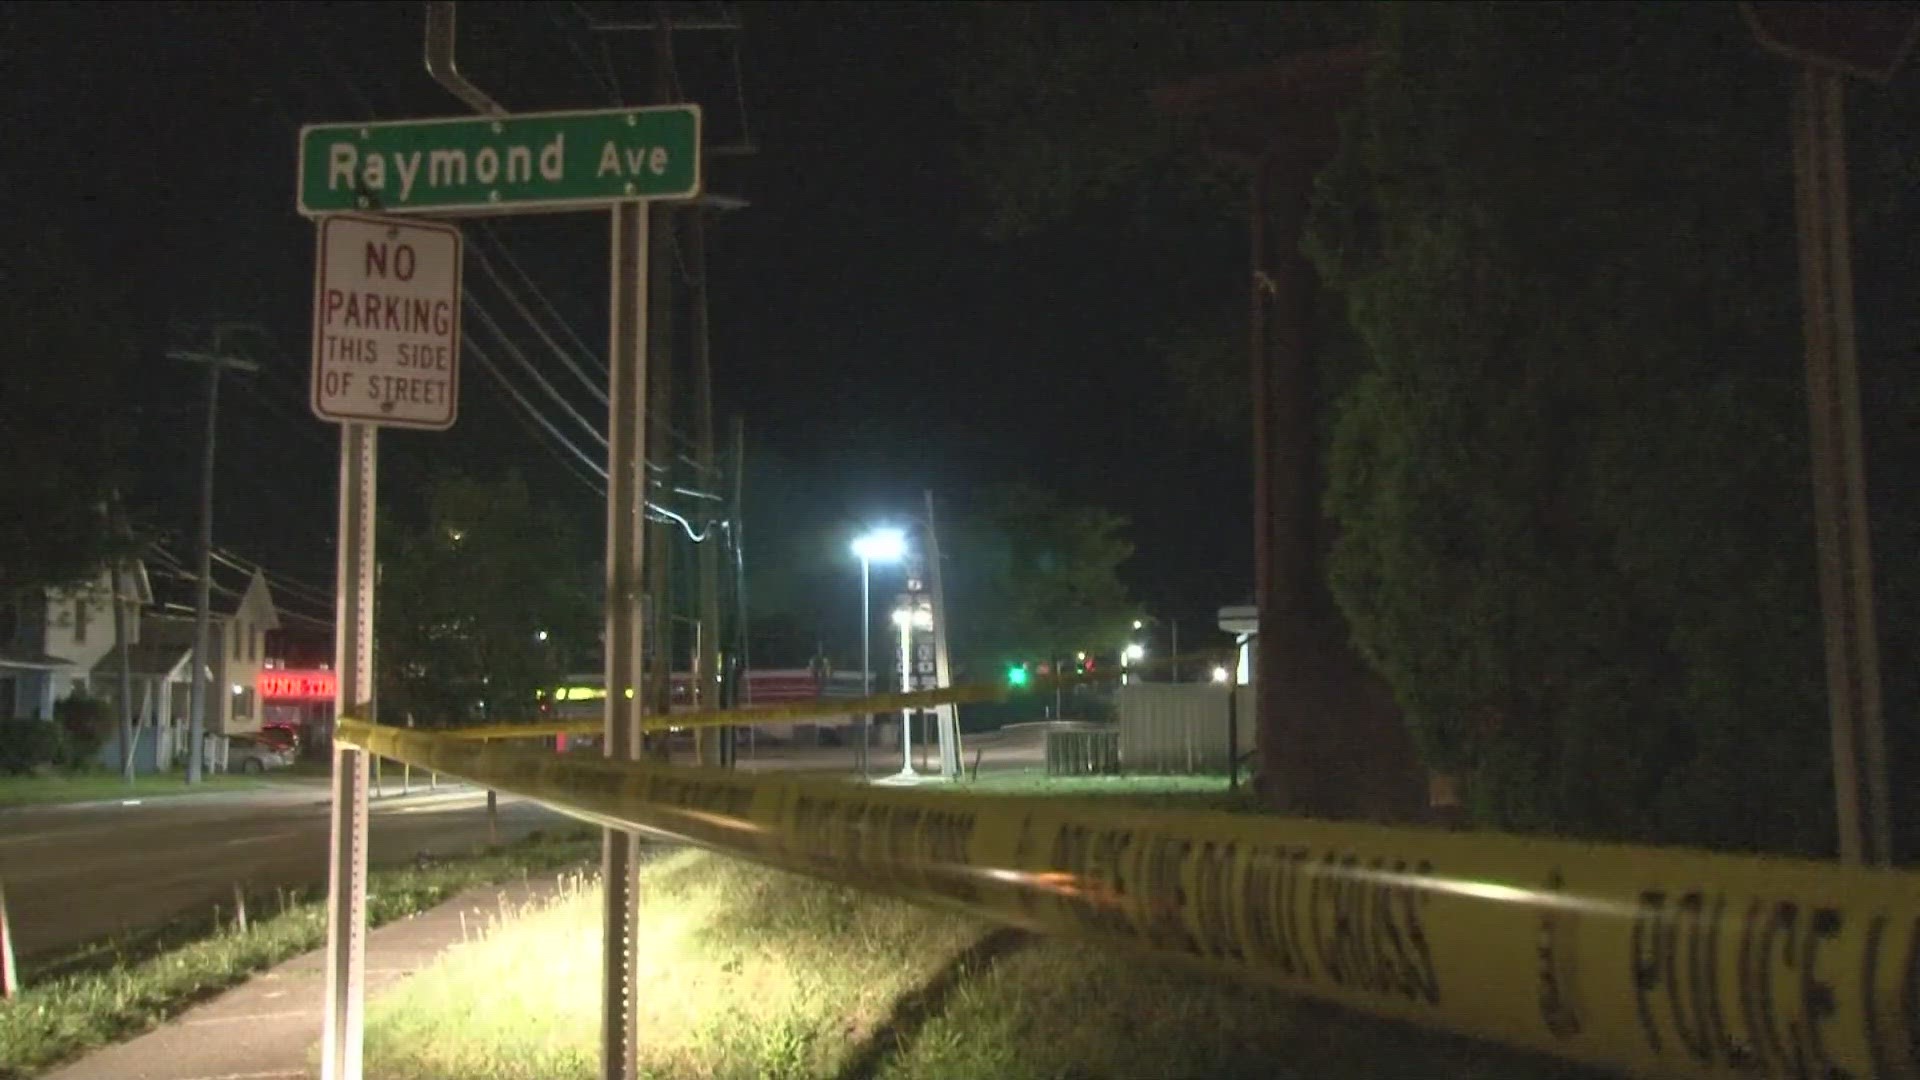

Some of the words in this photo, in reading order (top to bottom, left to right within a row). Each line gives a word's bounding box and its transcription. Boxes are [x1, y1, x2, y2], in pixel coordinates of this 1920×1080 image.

[328, 133, 564, 202] Raymond
[597, 140, 668, 178] Ave
[365, 240, 416, 281] NO
[326, 288, 449, 337] PARKING
[327, 335, 378, 364] THIS
[397, 342, 447, 371] SIDE
[325, 370, 353, 398] OF
[367, 374, 447, 405] STREET
